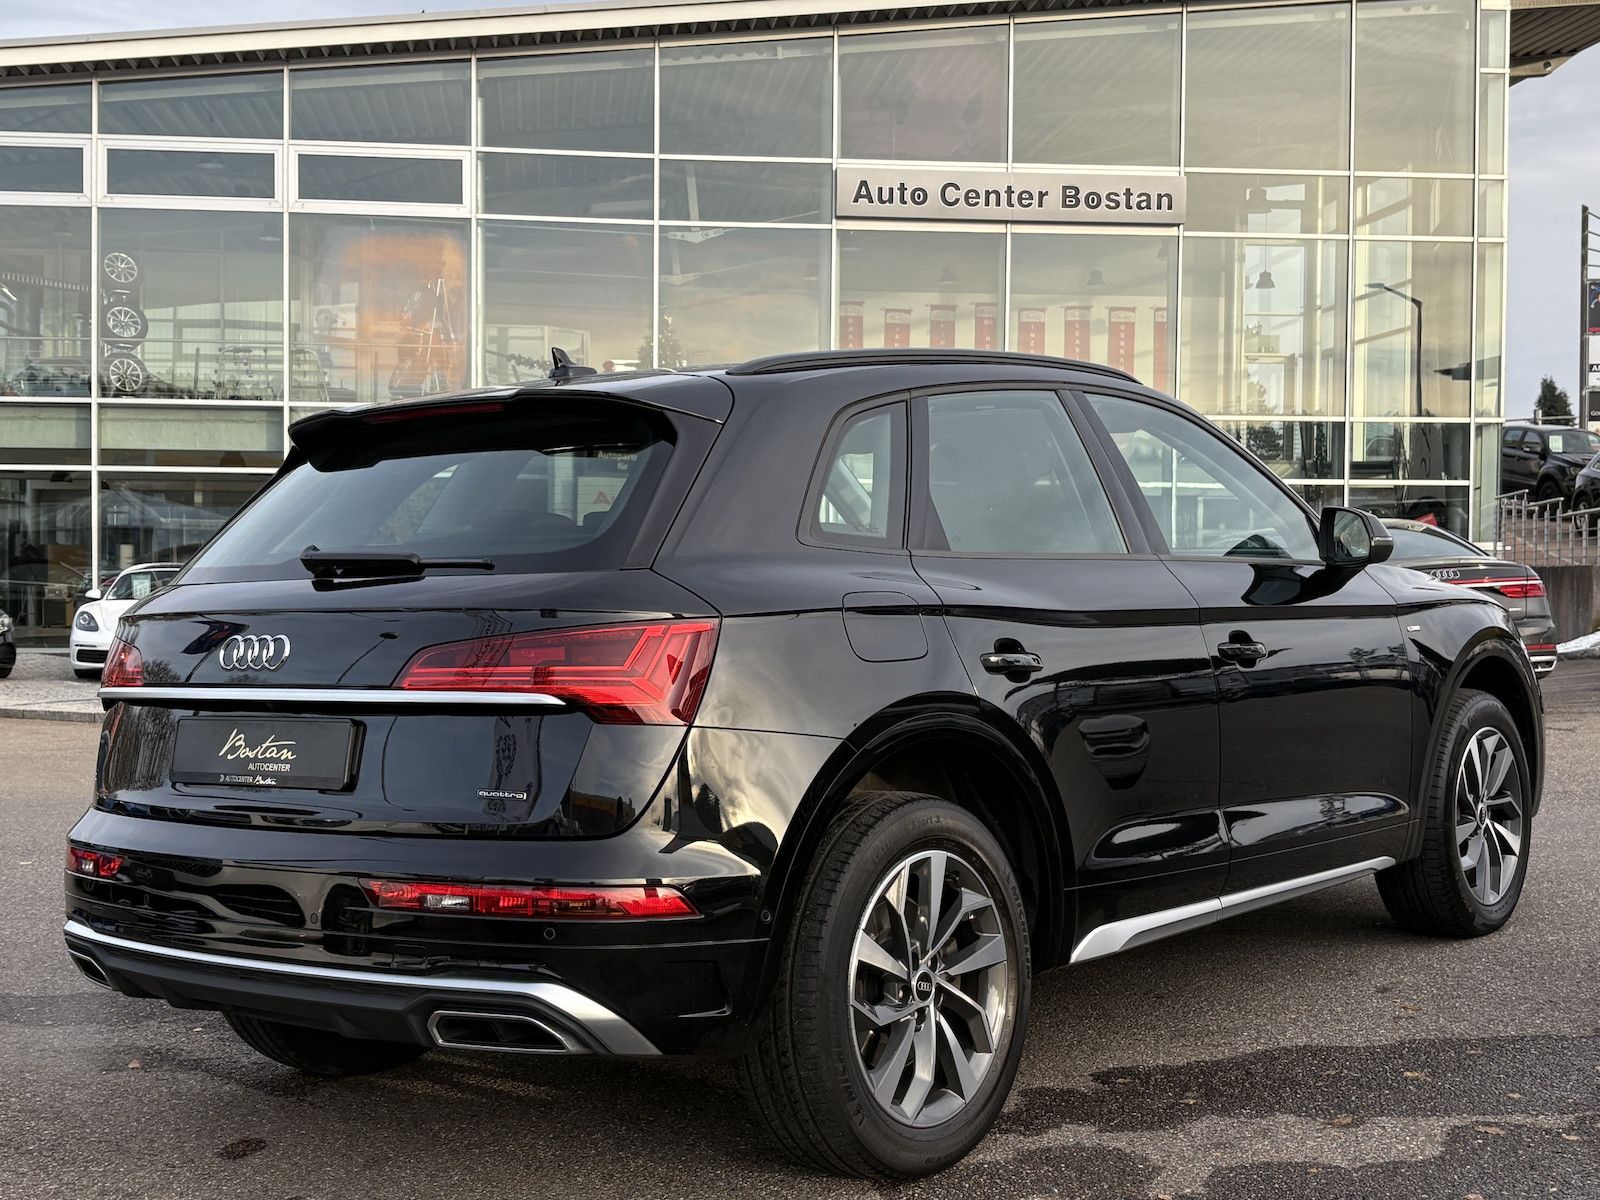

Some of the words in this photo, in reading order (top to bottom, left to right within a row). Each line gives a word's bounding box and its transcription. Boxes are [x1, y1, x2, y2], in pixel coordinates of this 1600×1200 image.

[852, 180, 929, 205] Auto
[939, 182, 1049, 209] Center
[1061, 185, 1174, 211] Bostan
[219, 728, 297, 760] Bostan
[248, 762, 291, 772] AUTOCENTER
[225, 775, 253, 783] AUTOCENTER
[478, 790, 525, 800] quattro
